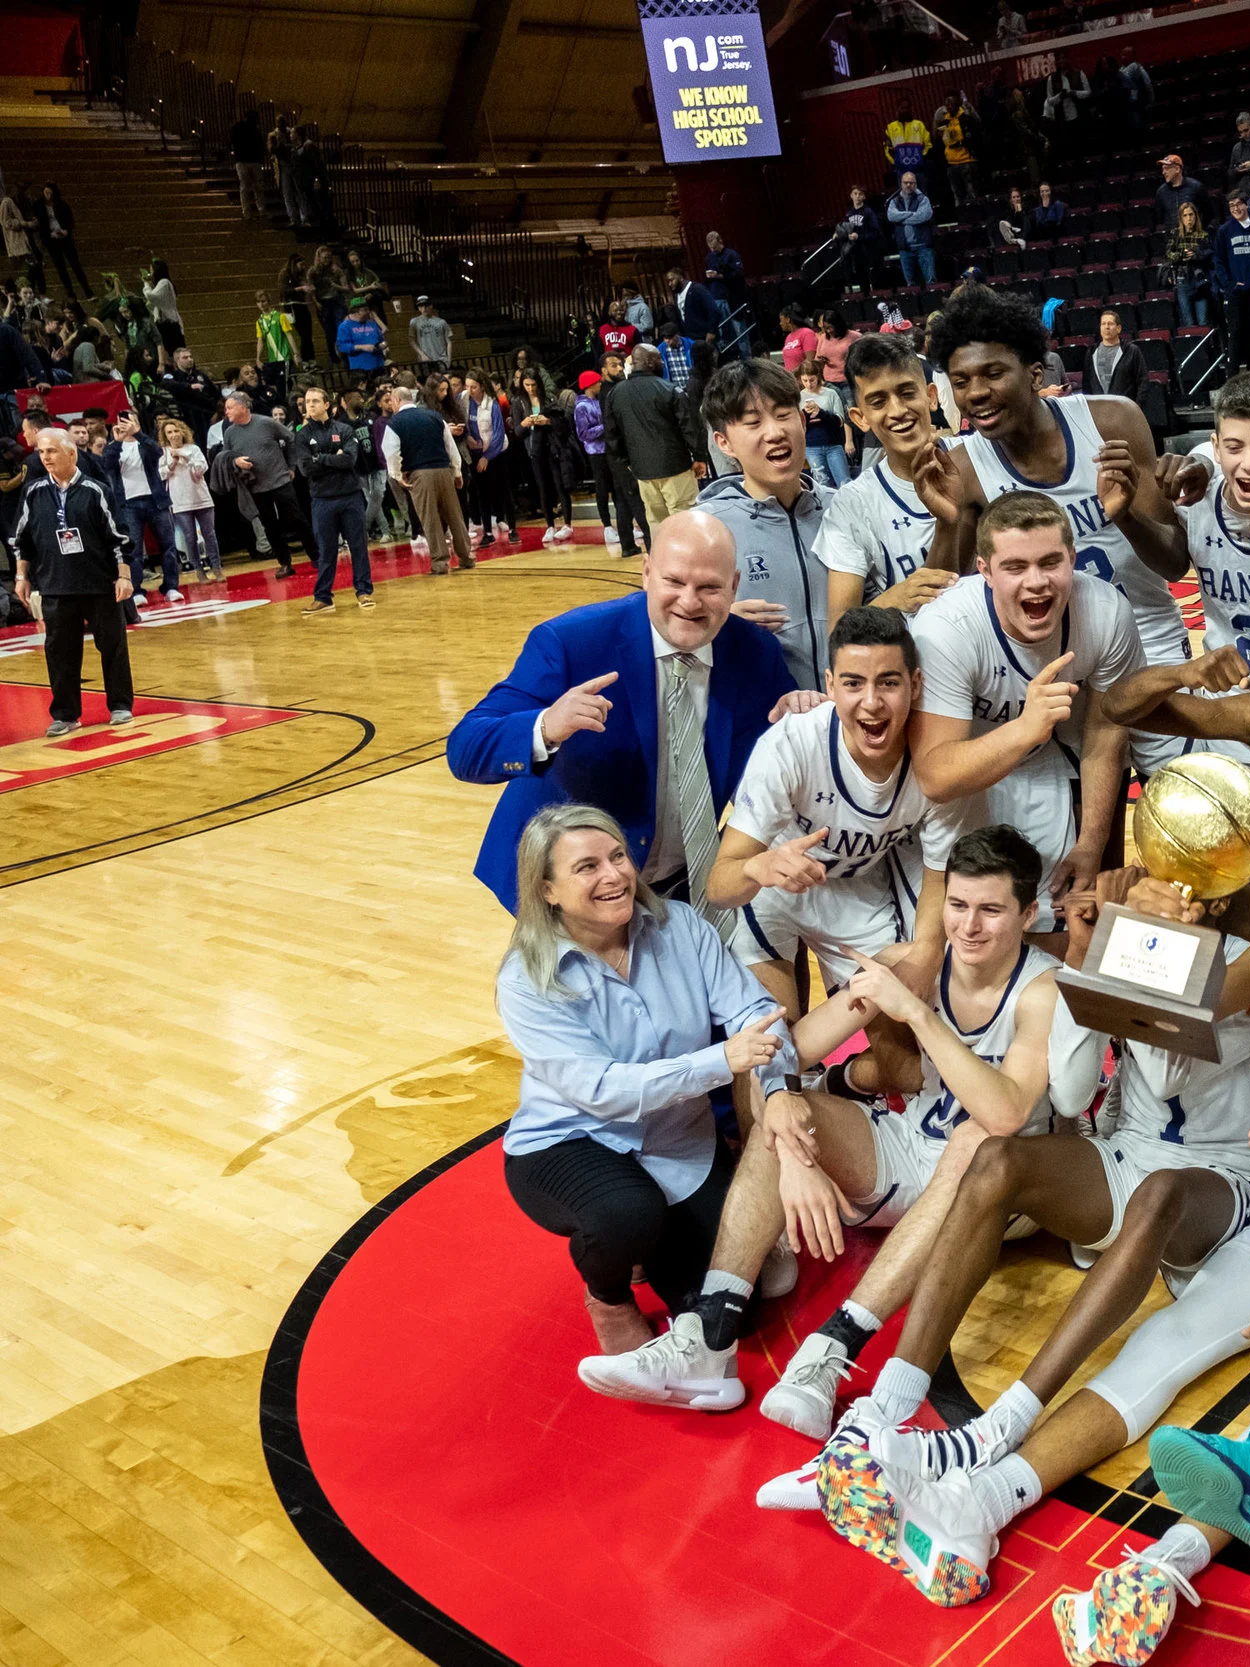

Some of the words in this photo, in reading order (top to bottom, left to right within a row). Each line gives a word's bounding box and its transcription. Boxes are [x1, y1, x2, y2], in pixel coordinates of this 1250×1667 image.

[718, 34, 744, 45] com
[720, 50, 740, 59] True
[722, 60, 752, 71] Jersey.
[678, 88, 704, 107] WE
[704, 84, 748, 105] KNOW
[672, 108, 709, 130] HIGH
[708, 105, 763, 127] SCHOOL
[694, 126, 749, 149] SPORTS
[744, 554, 769, 574] R
[749, 572, 770, 582] 2019
